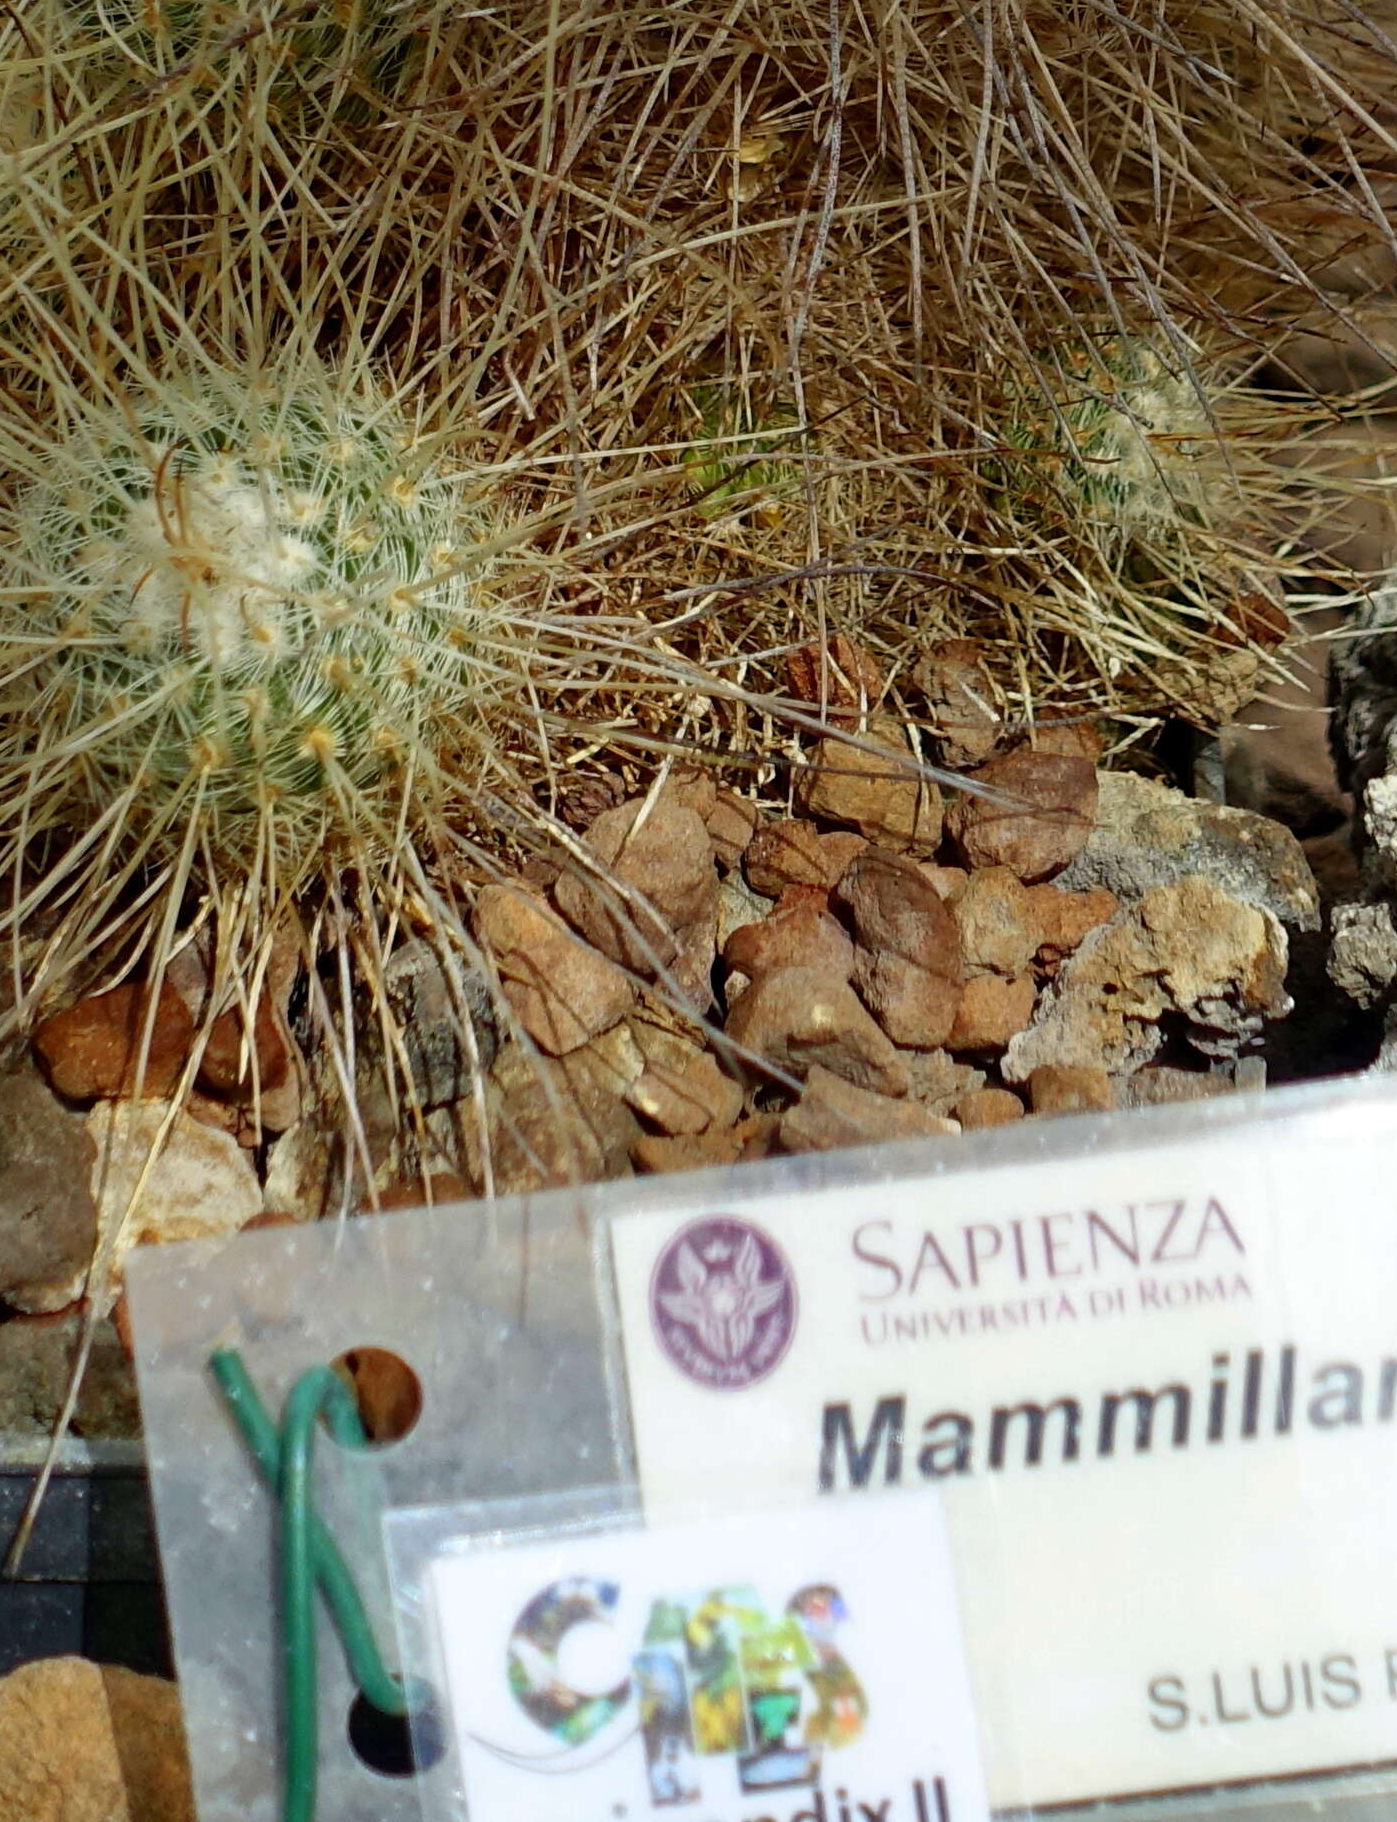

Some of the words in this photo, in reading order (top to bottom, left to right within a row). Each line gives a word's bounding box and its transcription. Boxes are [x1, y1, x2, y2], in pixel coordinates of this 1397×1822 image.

[851, 1195, 1247, 1302] SAPIENZA
[860, 1290, 1078, 1346] UNIVERSITÀ
[1088, 1285, 1126, 1318] DI
[1138, 1272, 1254, 1310] ROMA
[1146, 1653, 1364, 1734] S.LUIS
